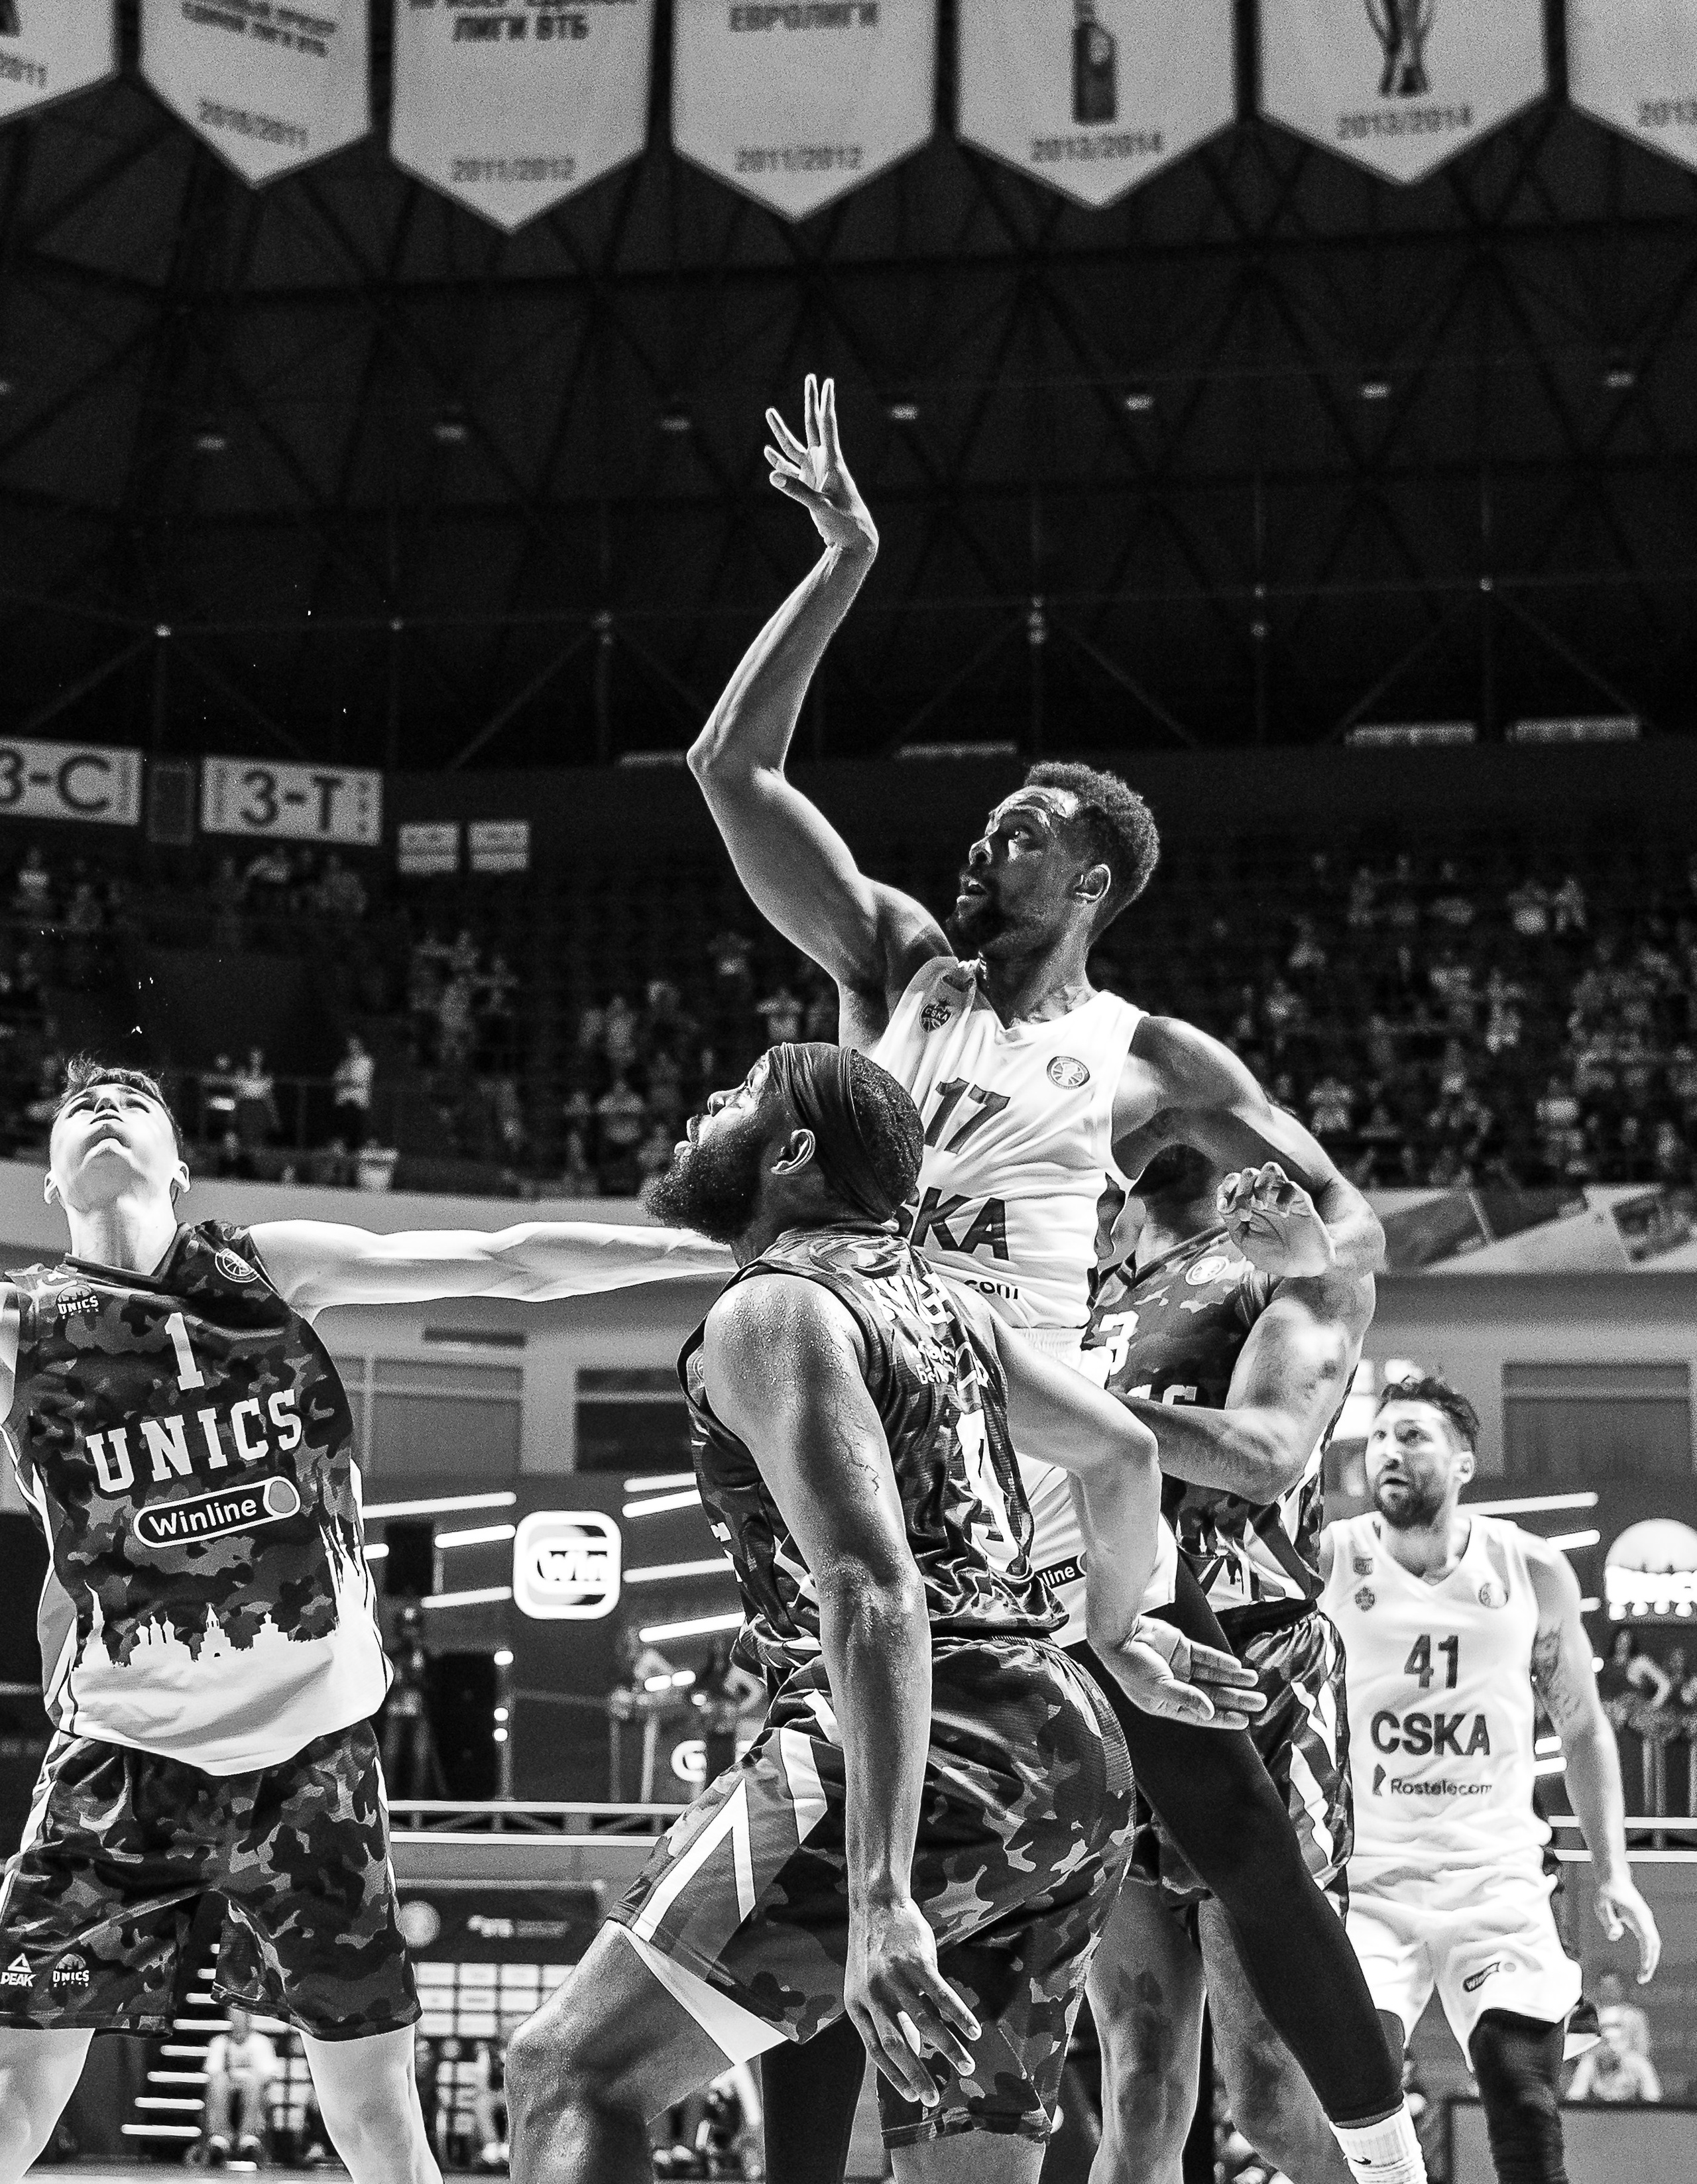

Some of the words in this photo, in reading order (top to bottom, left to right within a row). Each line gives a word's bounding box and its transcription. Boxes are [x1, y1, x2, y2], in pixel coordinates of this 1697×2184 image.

[925, 1007, 948, 1021] CSKA
[924, 1078, 1011, 1153] 17
[57, 1294, 99, 1315] UNICS
[164, 1312, 205, 1391] 1
[86, 1389, 302, 1493] UNICS
[148, 1499, 257, 1536] Winline
[1404, 1634, 1458, 1689] 41
[1370, 1709, 1490, 1756] CSKA
[1390, 1778, 1493, 1796] Rostelecom
[0, 1971, 37, 1987] PEAK
[52, 1969, 90, 1983] UNICS
